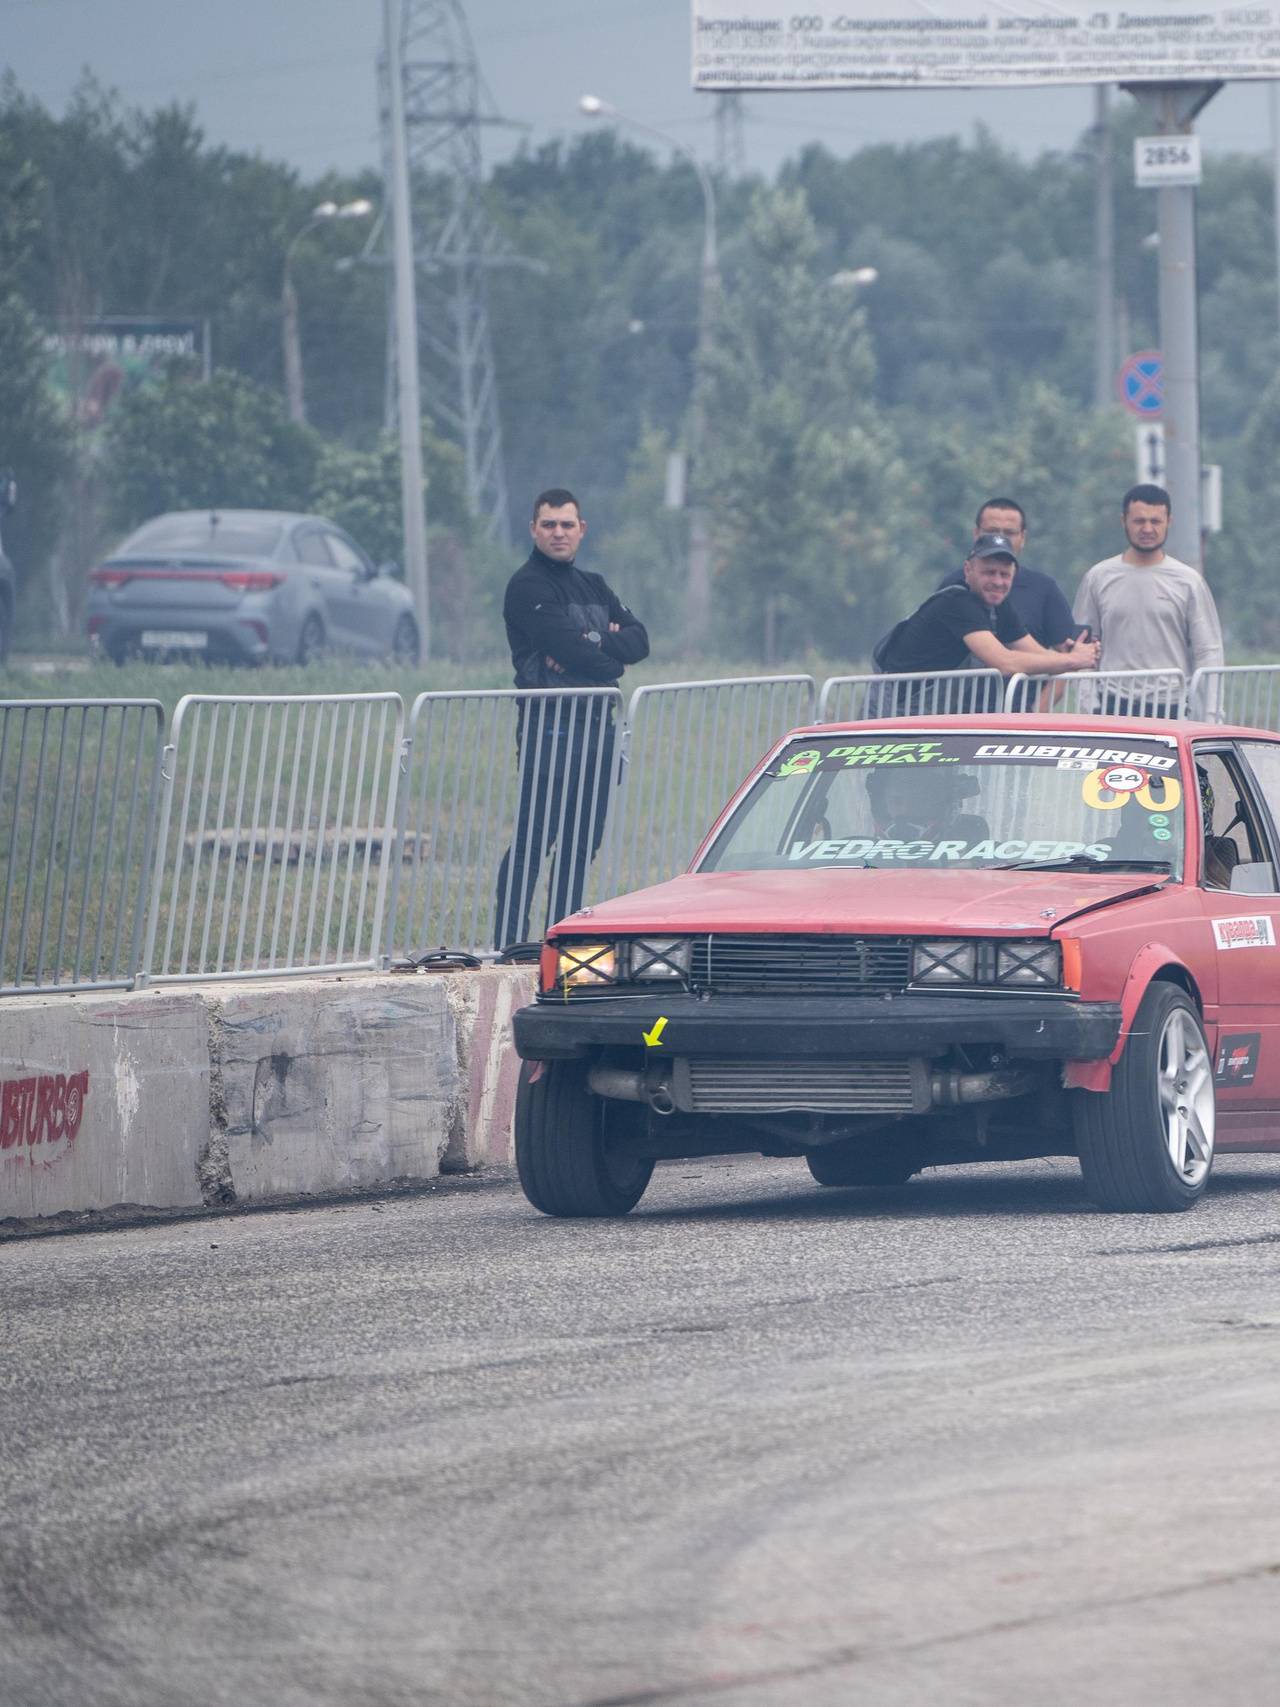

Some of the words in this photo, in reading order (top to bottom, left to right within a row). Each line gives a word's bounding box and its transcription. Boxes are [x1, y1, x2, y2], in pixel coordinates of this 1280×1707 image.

[790, 15, 823, 31] ООО
[826, 743, 942, 757] DRIFT
[974, 745, 1176, 769] CLUBTURBO
[1108, 774, 1139, 784] 24
[1082, 769, 1181, 811] 60
[0, 1070, 89, 1149] BTURBO
